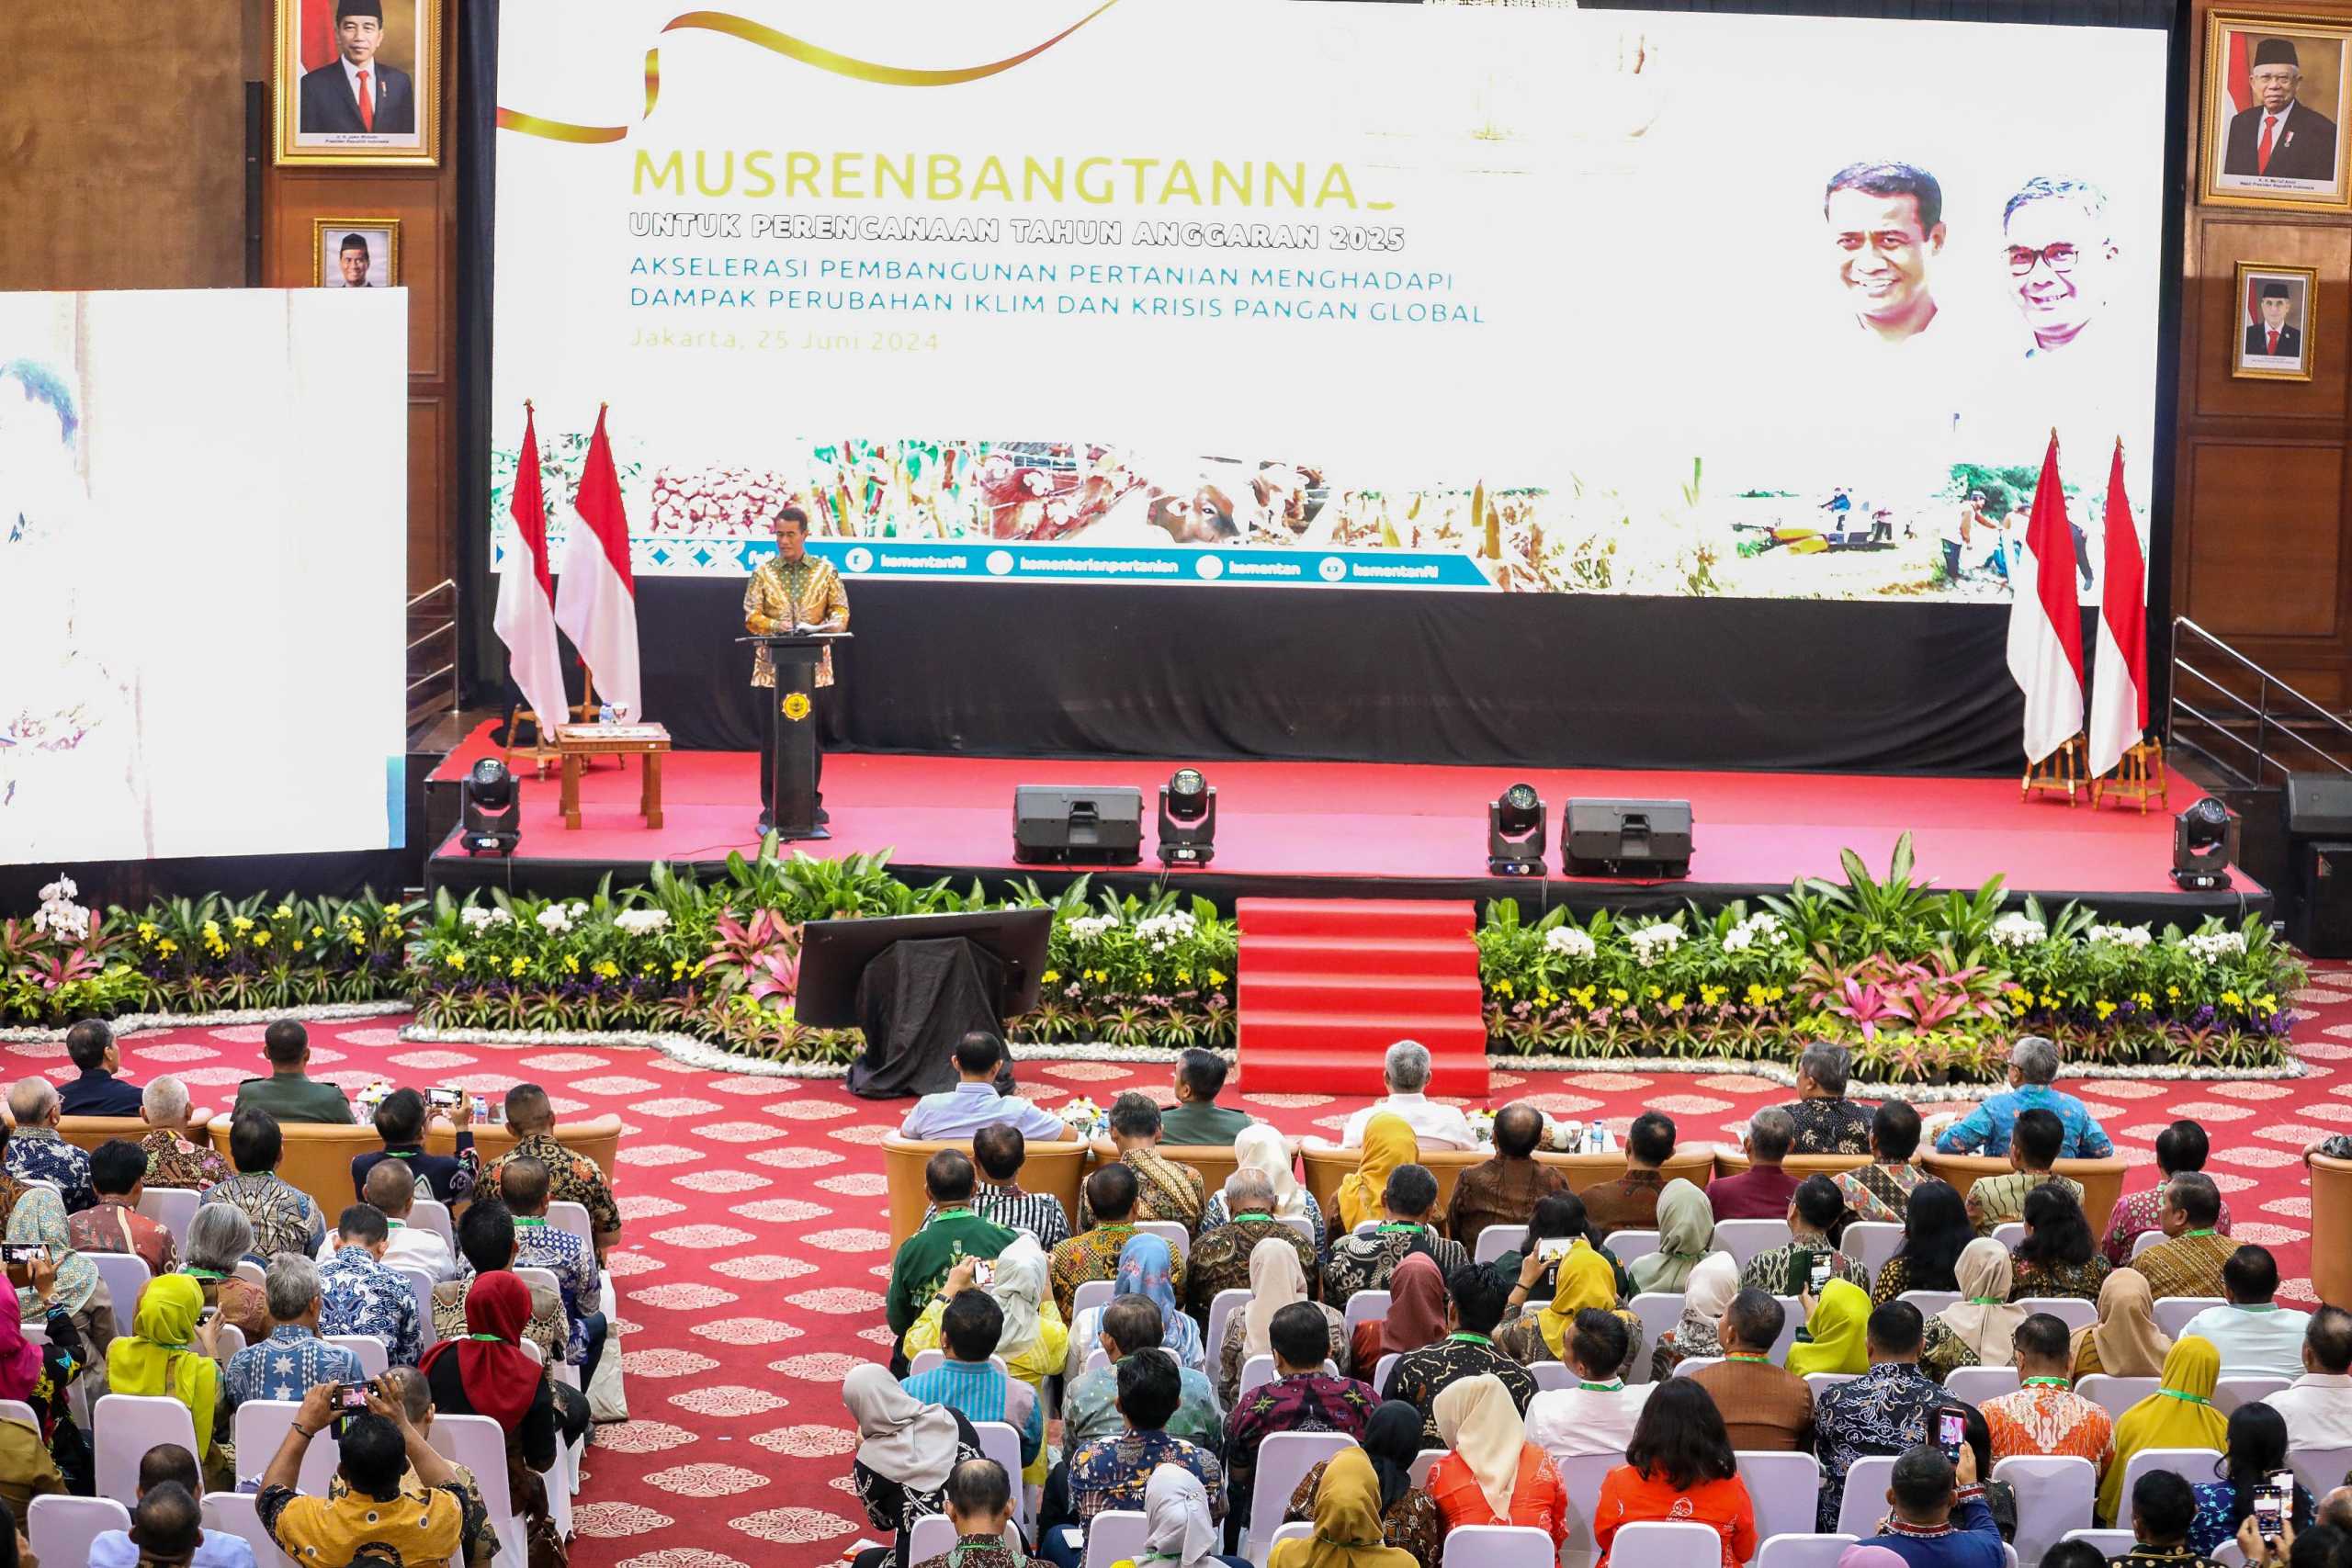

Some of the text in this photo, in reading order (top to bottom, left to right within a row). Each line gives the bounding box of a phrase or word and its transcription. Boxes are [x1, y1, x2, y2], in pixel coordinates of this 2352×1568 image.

[632, 149, 1396, 210] MUSRENBANGTANNA
[629, 212, 1405, 253] UNTUK PERENCANAAN TAHUN ANGGARAN 2025
[630, 257, 1453, 291] AKSELERASI PEMBANGUNAN PERTANIAN MENGHADAPI
[631, 287, 1486, 324] DAMPAK PERUBAHAN IKLIM DAN KRISIS PANGAN GLOBAL
[630, 327, 941, 353] Jakarta, 25 Juni 2024
